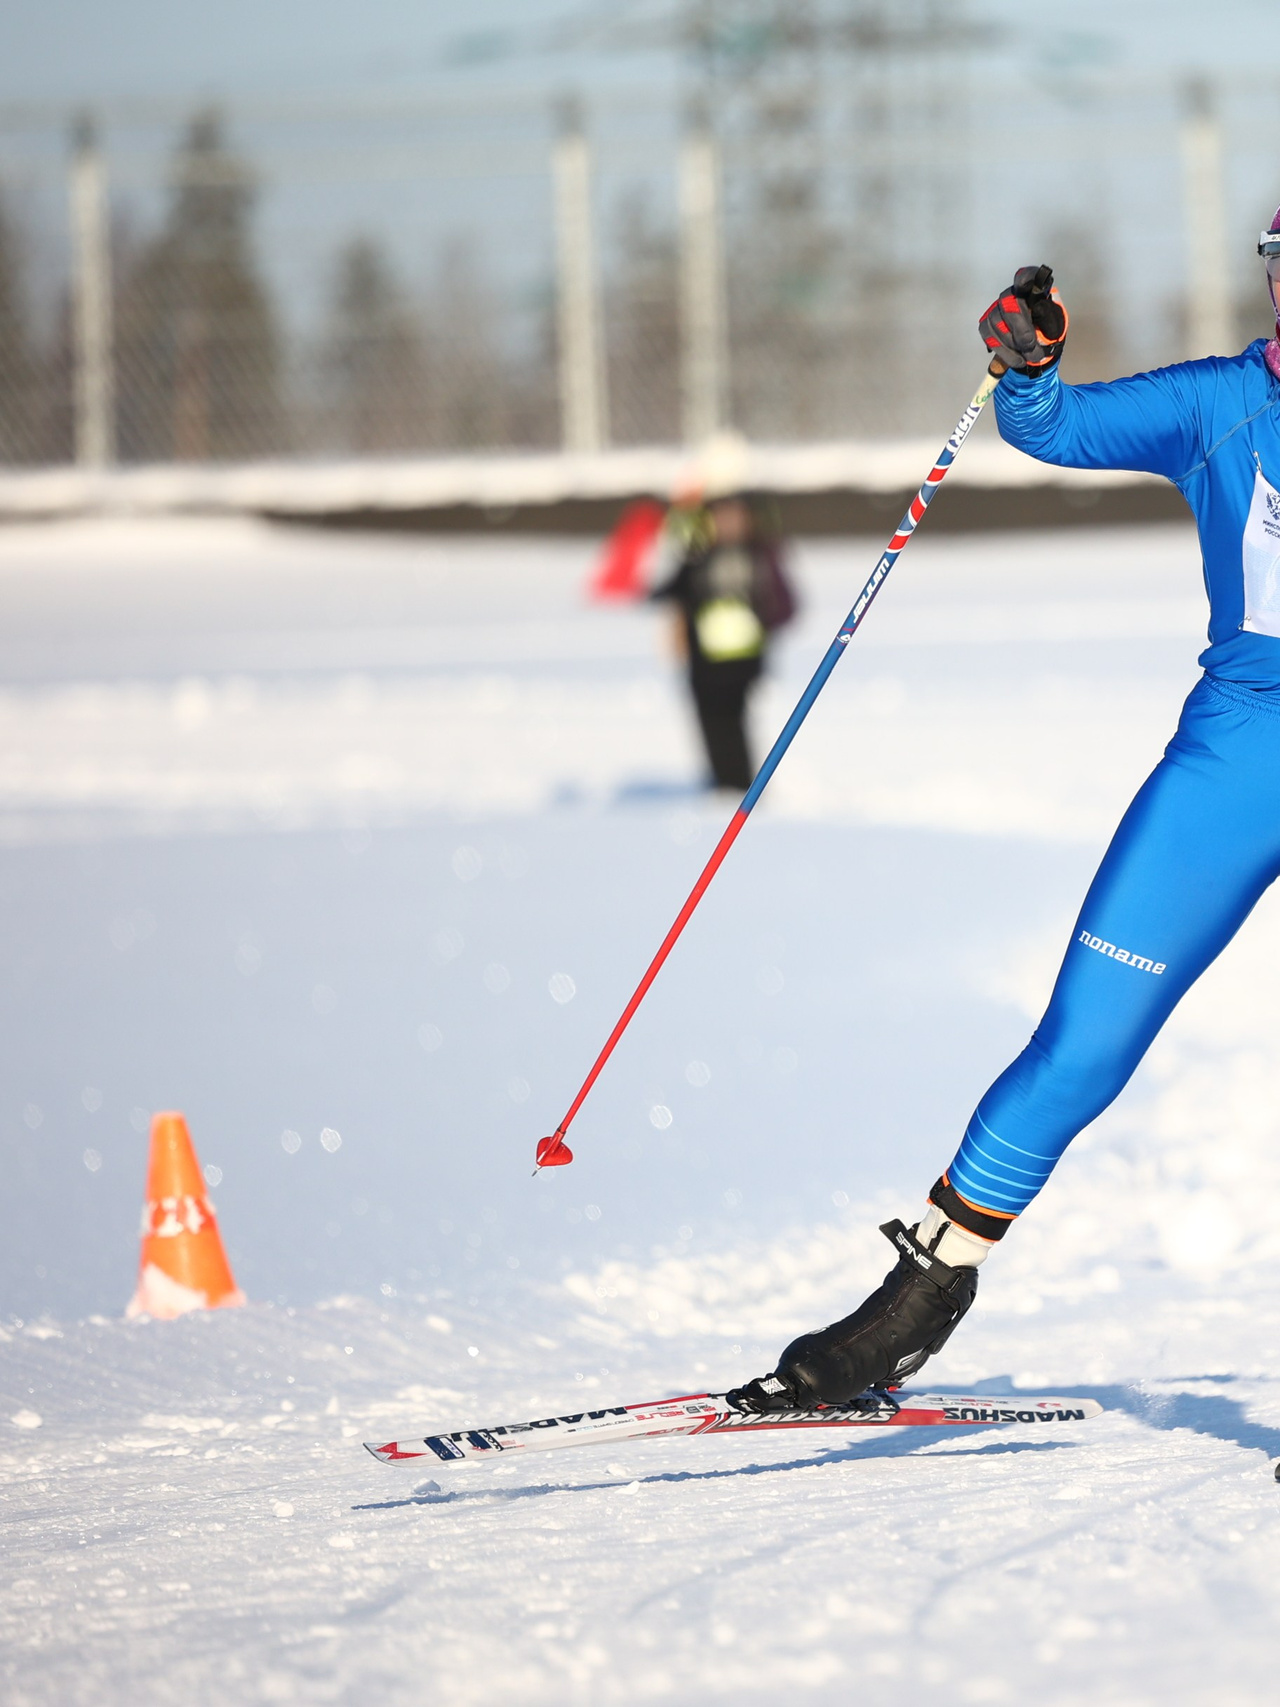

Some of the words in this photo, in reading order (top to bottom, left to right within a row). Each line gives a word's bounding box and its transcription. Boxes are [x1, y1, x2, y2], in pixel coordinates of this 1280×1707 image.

[1078, 930, 1167, 975] noname
[895, 1231, 933, 1270] SPINE
[719, 1410, 897, 1428] MADSHUS
[942, 1407, 1086, 1423] MADSHUS
